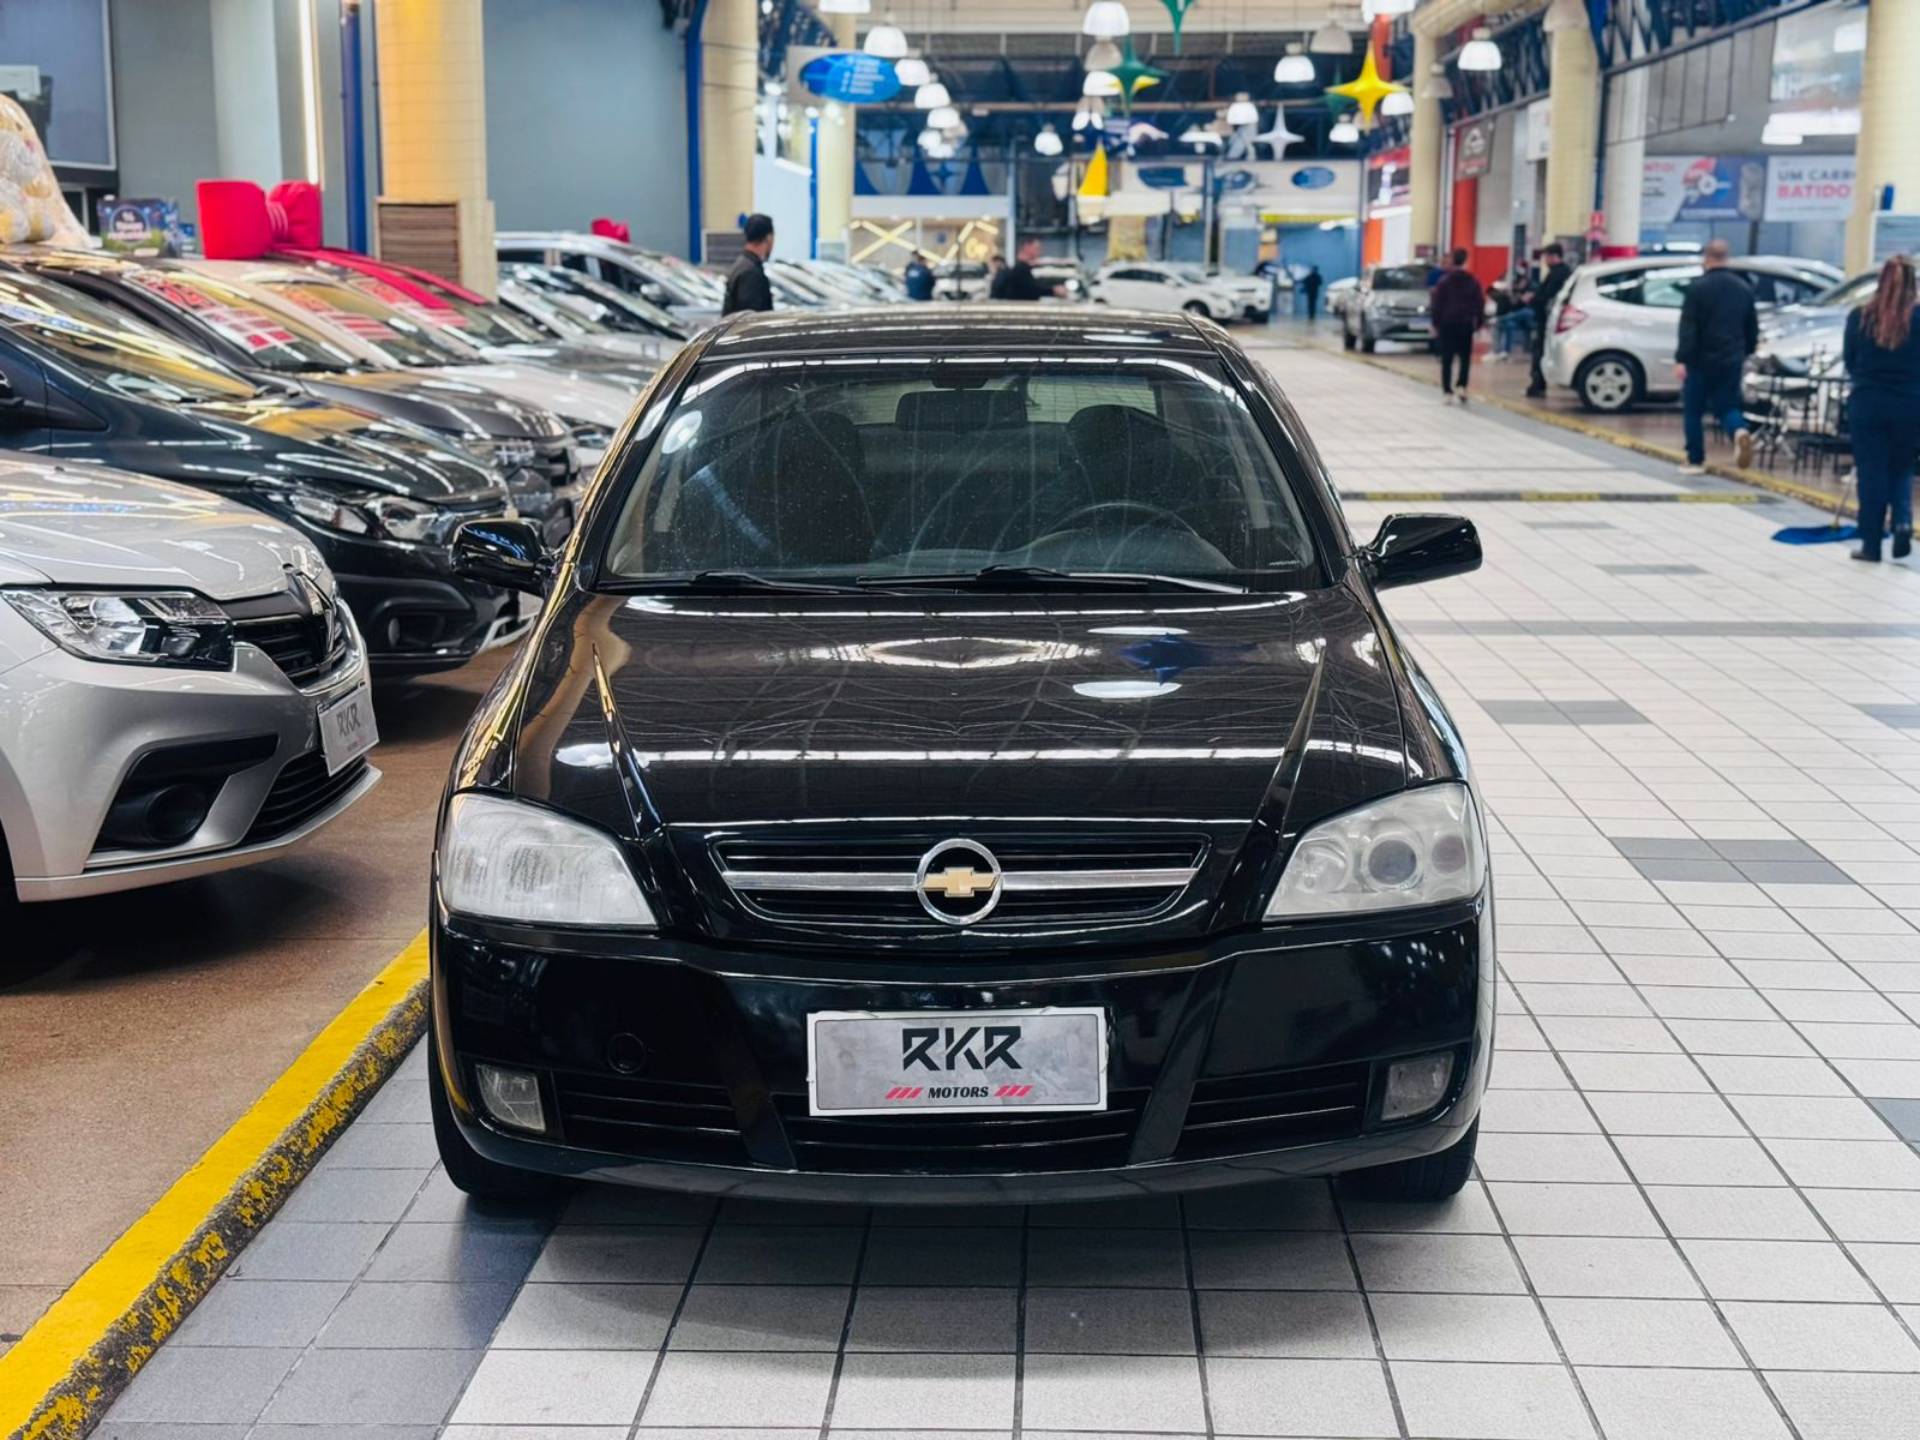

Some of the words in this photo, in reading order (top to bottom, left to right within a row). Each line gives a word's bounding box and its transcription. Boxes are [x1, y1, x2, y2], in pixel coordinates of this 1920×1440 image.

[1778, 170, 1802, 180] UM
[1777, 184, 1851, 198] BATIDO
[336, 702, 361, 736] RKR
[902, 1026, 1022, 1071] RKR
[928, 1086, 989, 1099] MOTORS
